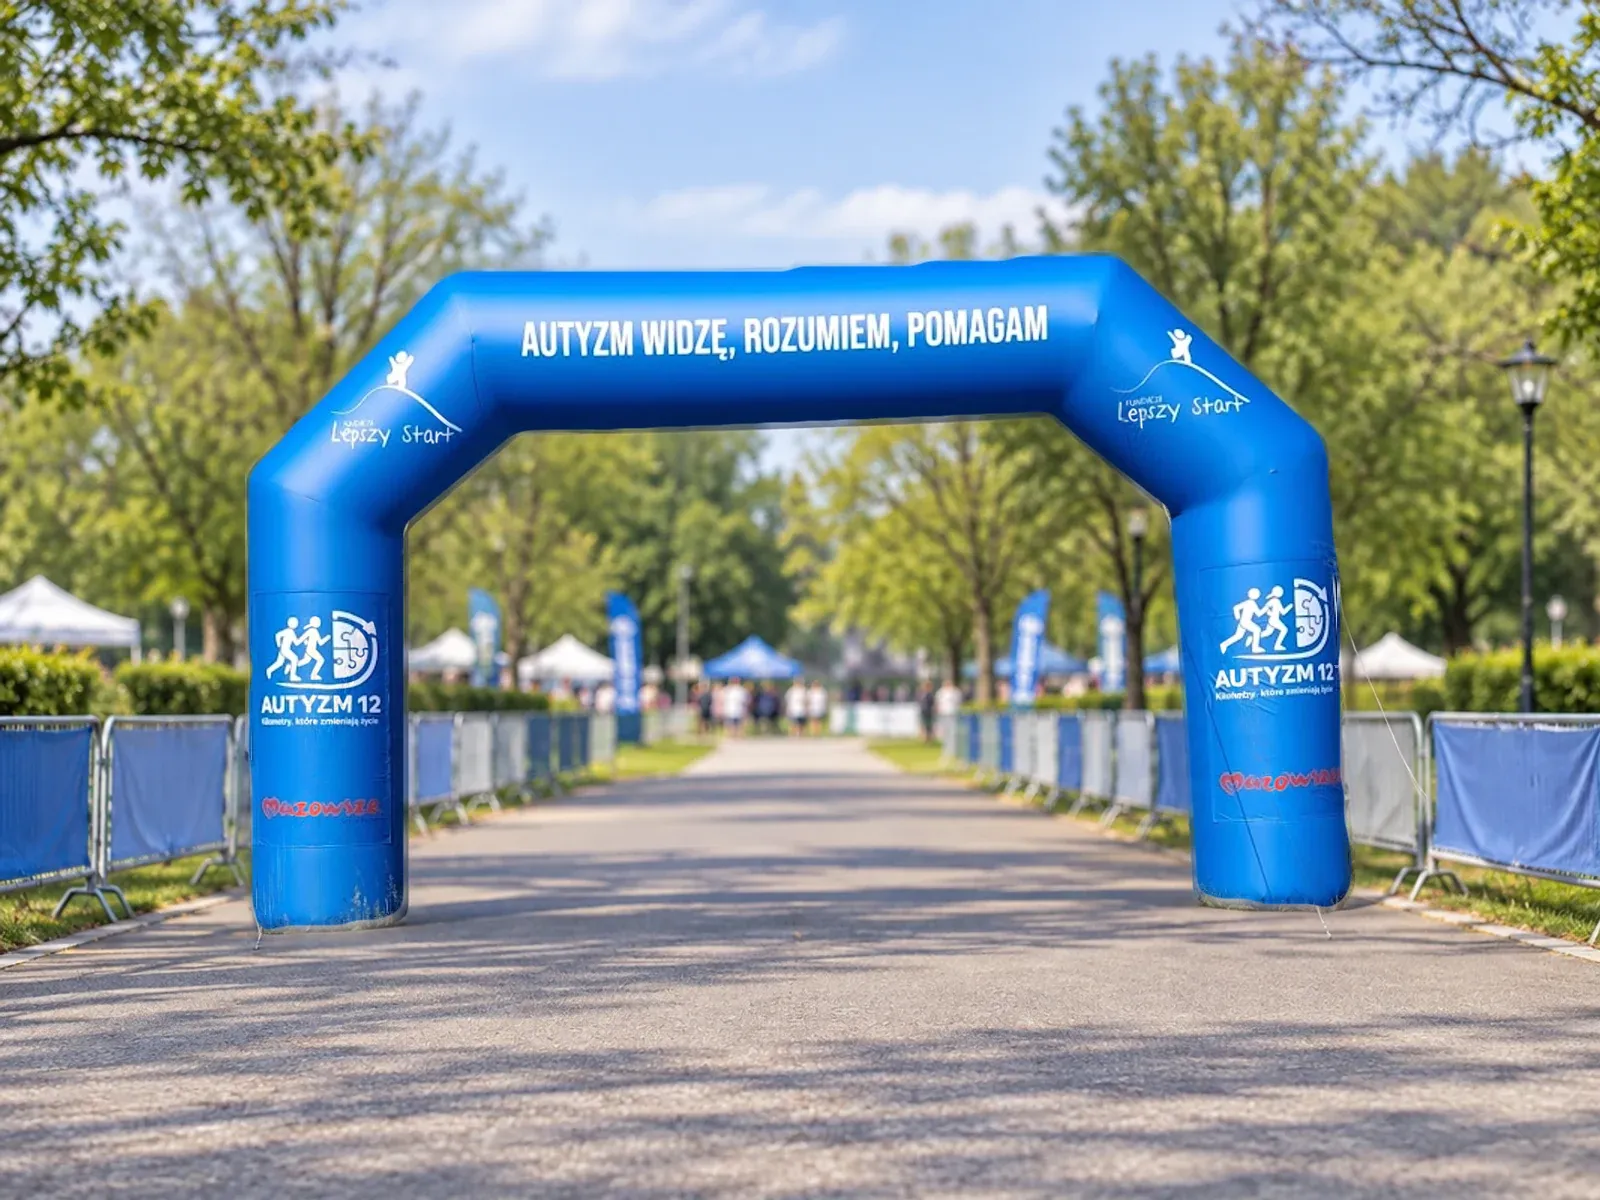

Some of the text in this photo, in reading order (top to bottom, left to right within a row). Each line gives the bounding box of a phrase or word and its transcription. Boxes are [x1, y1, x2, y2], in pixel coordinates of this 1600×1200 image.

[521, 305, 1048, 361] AUTYZM WIDZĘ, ROZUMIEM, POMAGAM
[1117, 396, 1243, 430] Lepszy Start
[331, 420, 391, 449] Lepszy
[402, 424, 454, 444] Start
[1215, 663, 1335, 689] AUTYZM 12
[261, 695, 381, 714] AUTYZM 12
